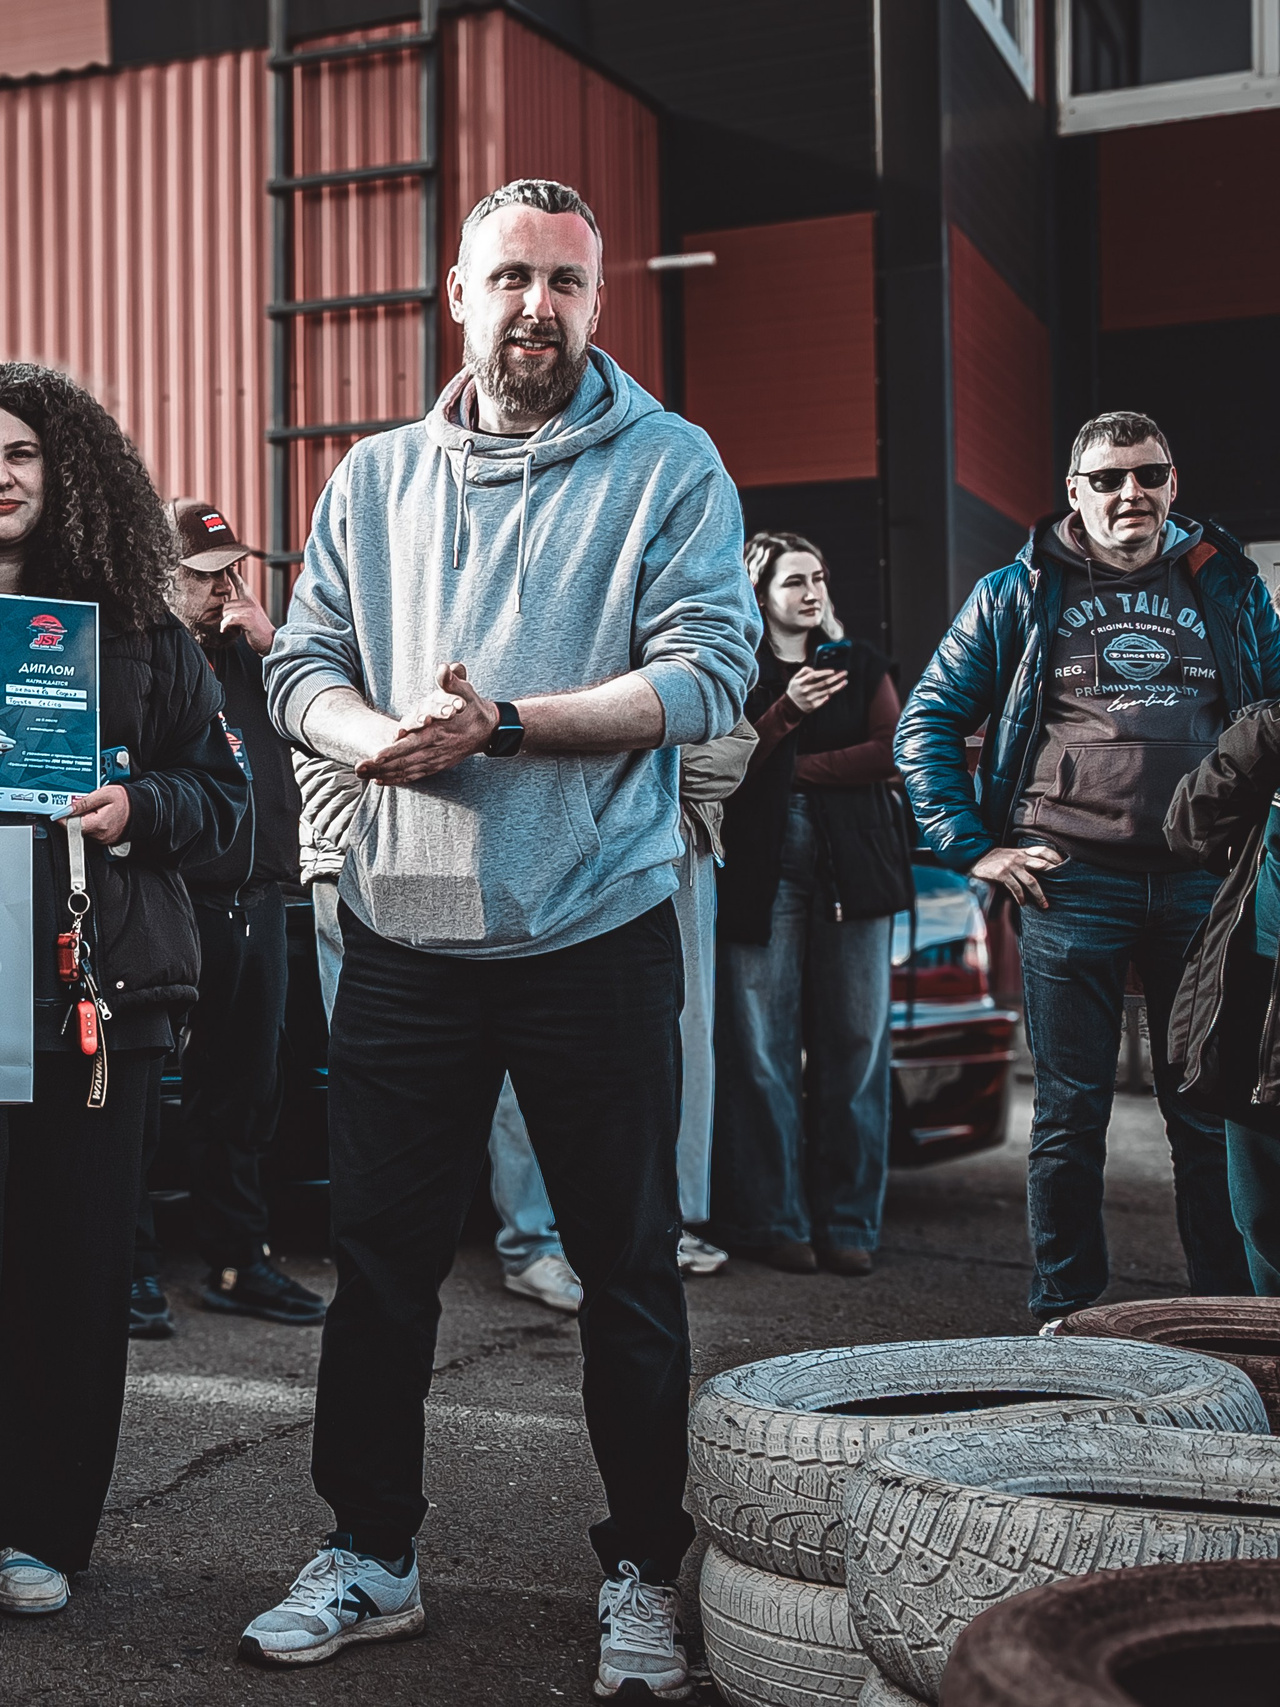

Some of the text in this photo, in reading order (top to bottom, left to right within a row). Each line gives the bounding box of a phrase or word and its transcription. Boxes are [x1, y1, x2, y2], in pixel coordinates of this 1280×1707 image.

[1135, 622, 1176, 636] SUPPLIES
[34, 634, 61, 646] JST
[18, 662, 75, 676] ДИПЛОМ
[1054, 664, 1216, 680] REG. TRMK
[1075, 684, 1199, 698] PREMIUM QUALITY
[1106, 692, 1180, 713] Essentials
[51, 793, 69, 801] WOW
